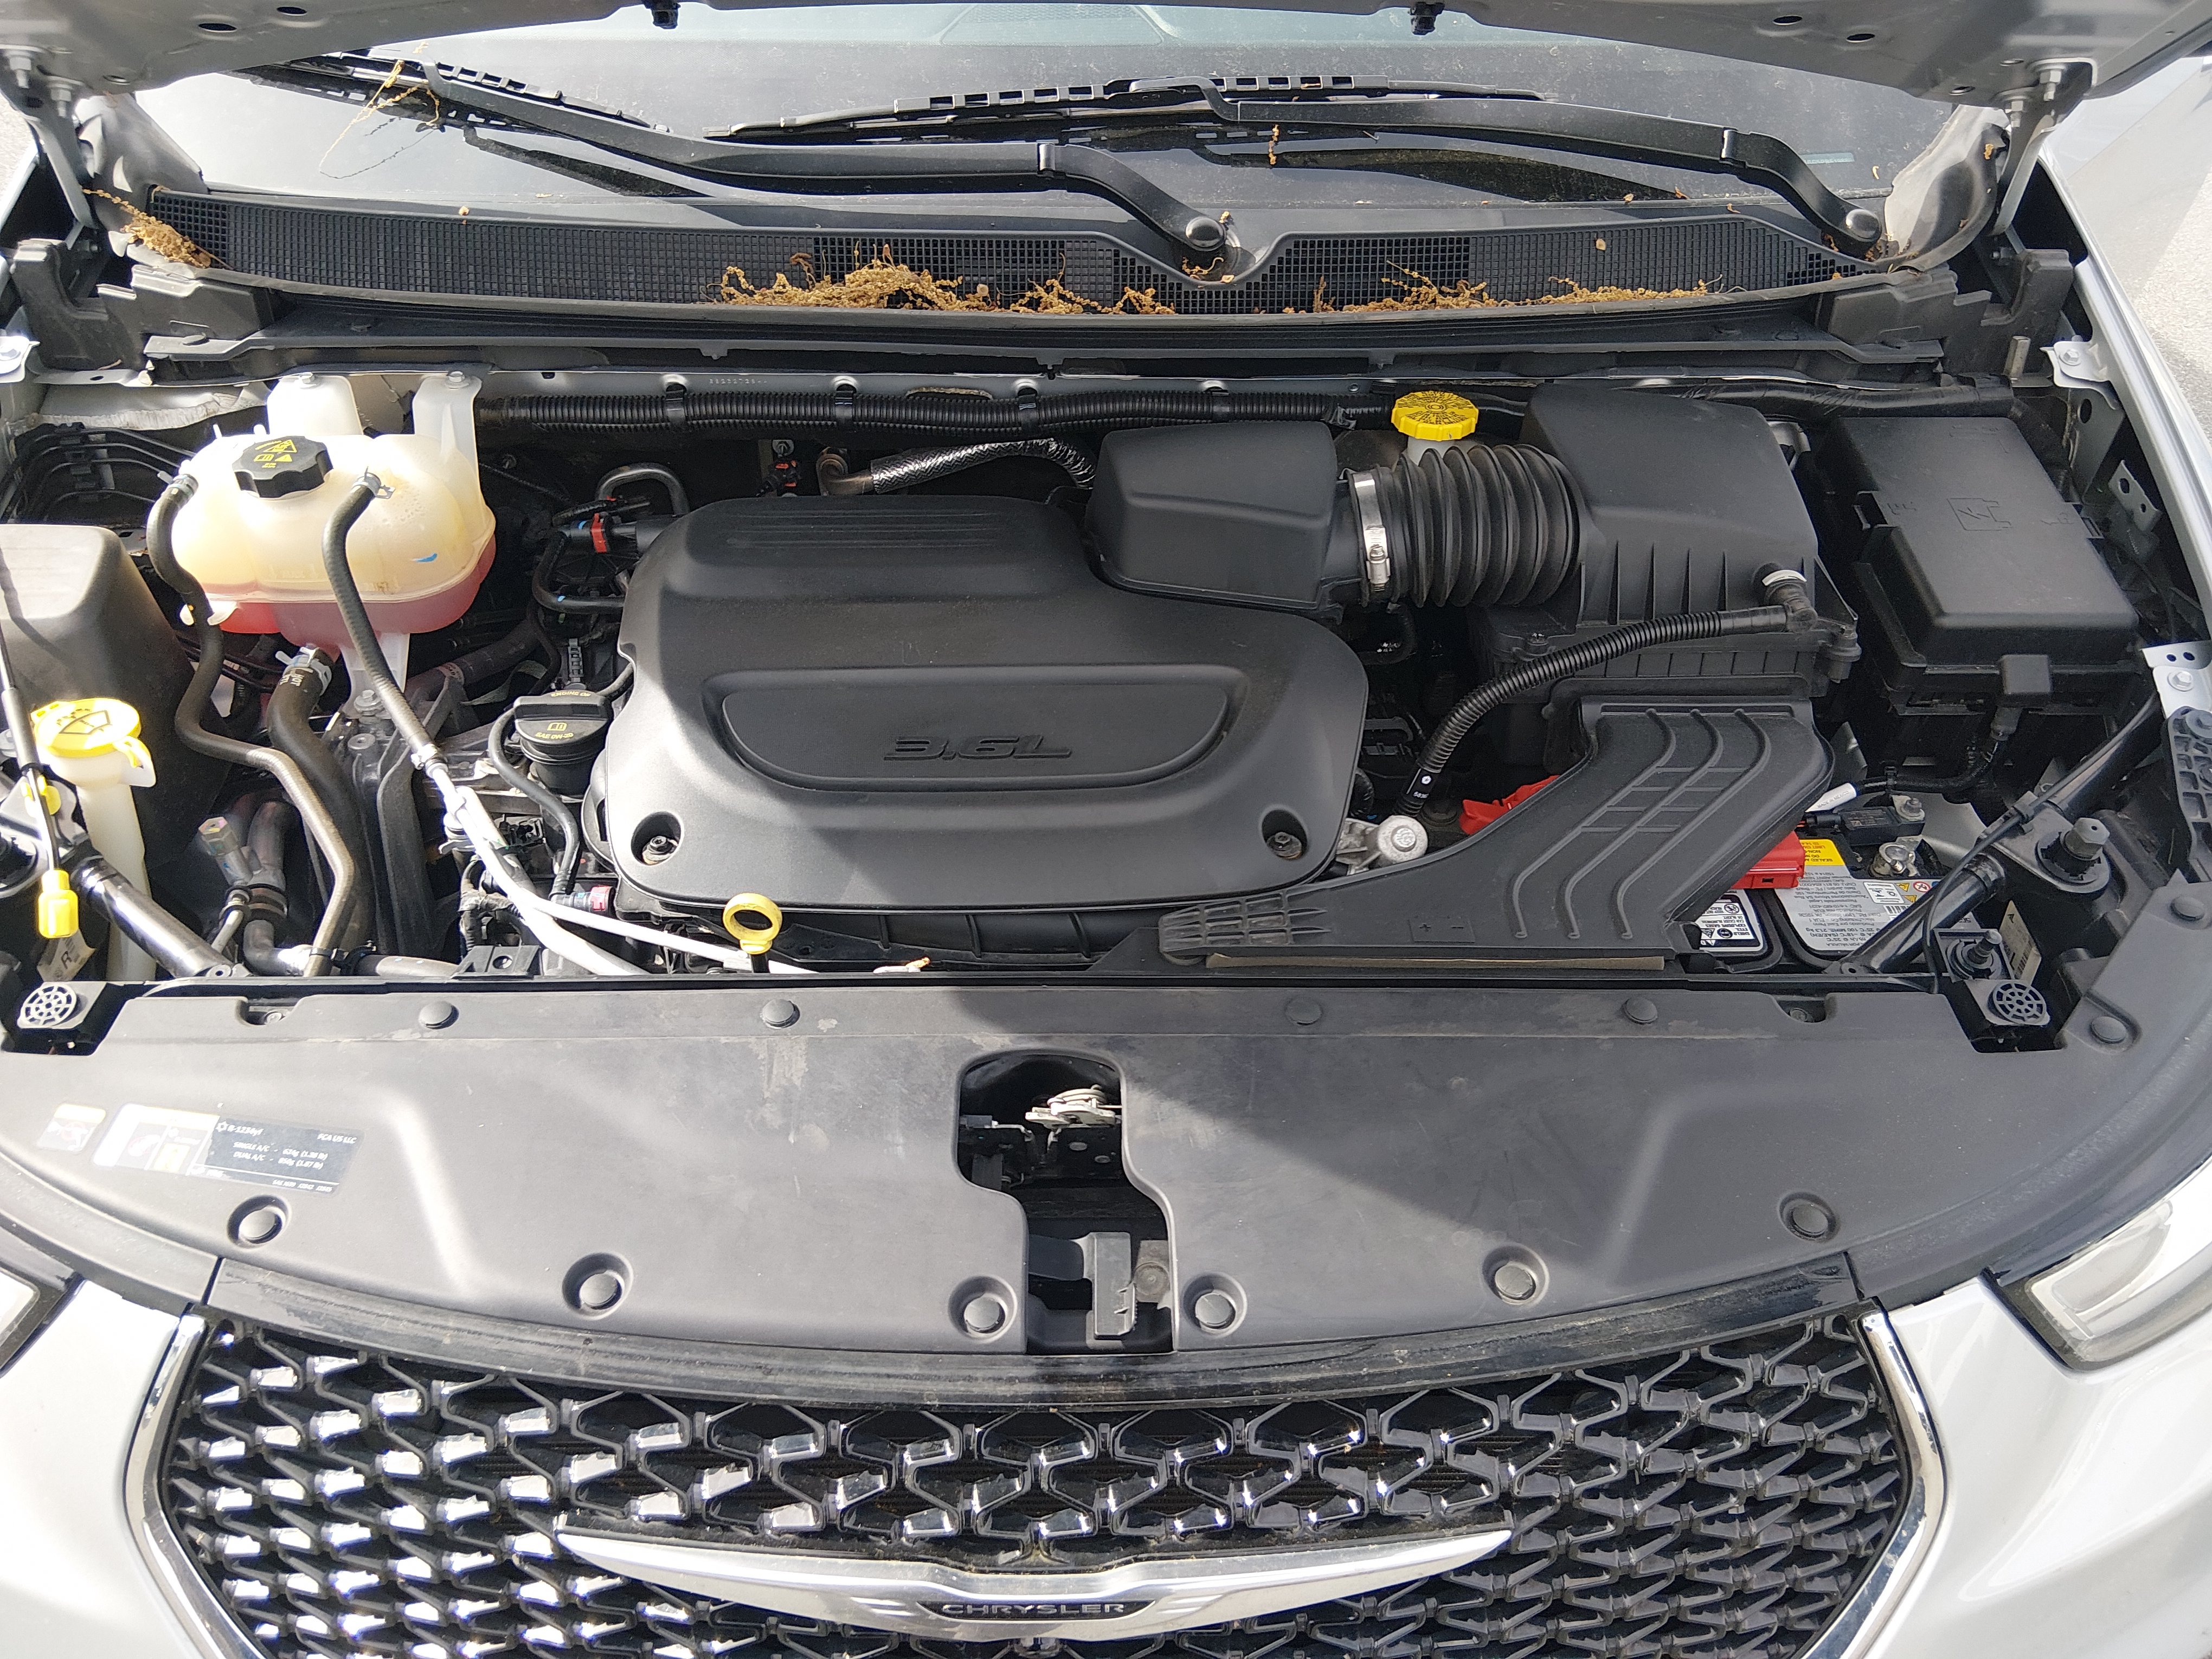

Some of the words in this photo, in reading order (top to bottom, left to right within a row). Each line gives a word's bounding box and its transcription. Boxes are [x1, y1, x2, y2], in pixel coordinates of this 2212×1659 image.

[884, 736, 1072, 761] 3.6L
[61, 950, 72, 969] R
[227, 1125, 264, 1136] R-1234yf
[233, 1142, 258, 1150] SINGLE
[942, 1603, 1124, 1615] CHRYSLER
